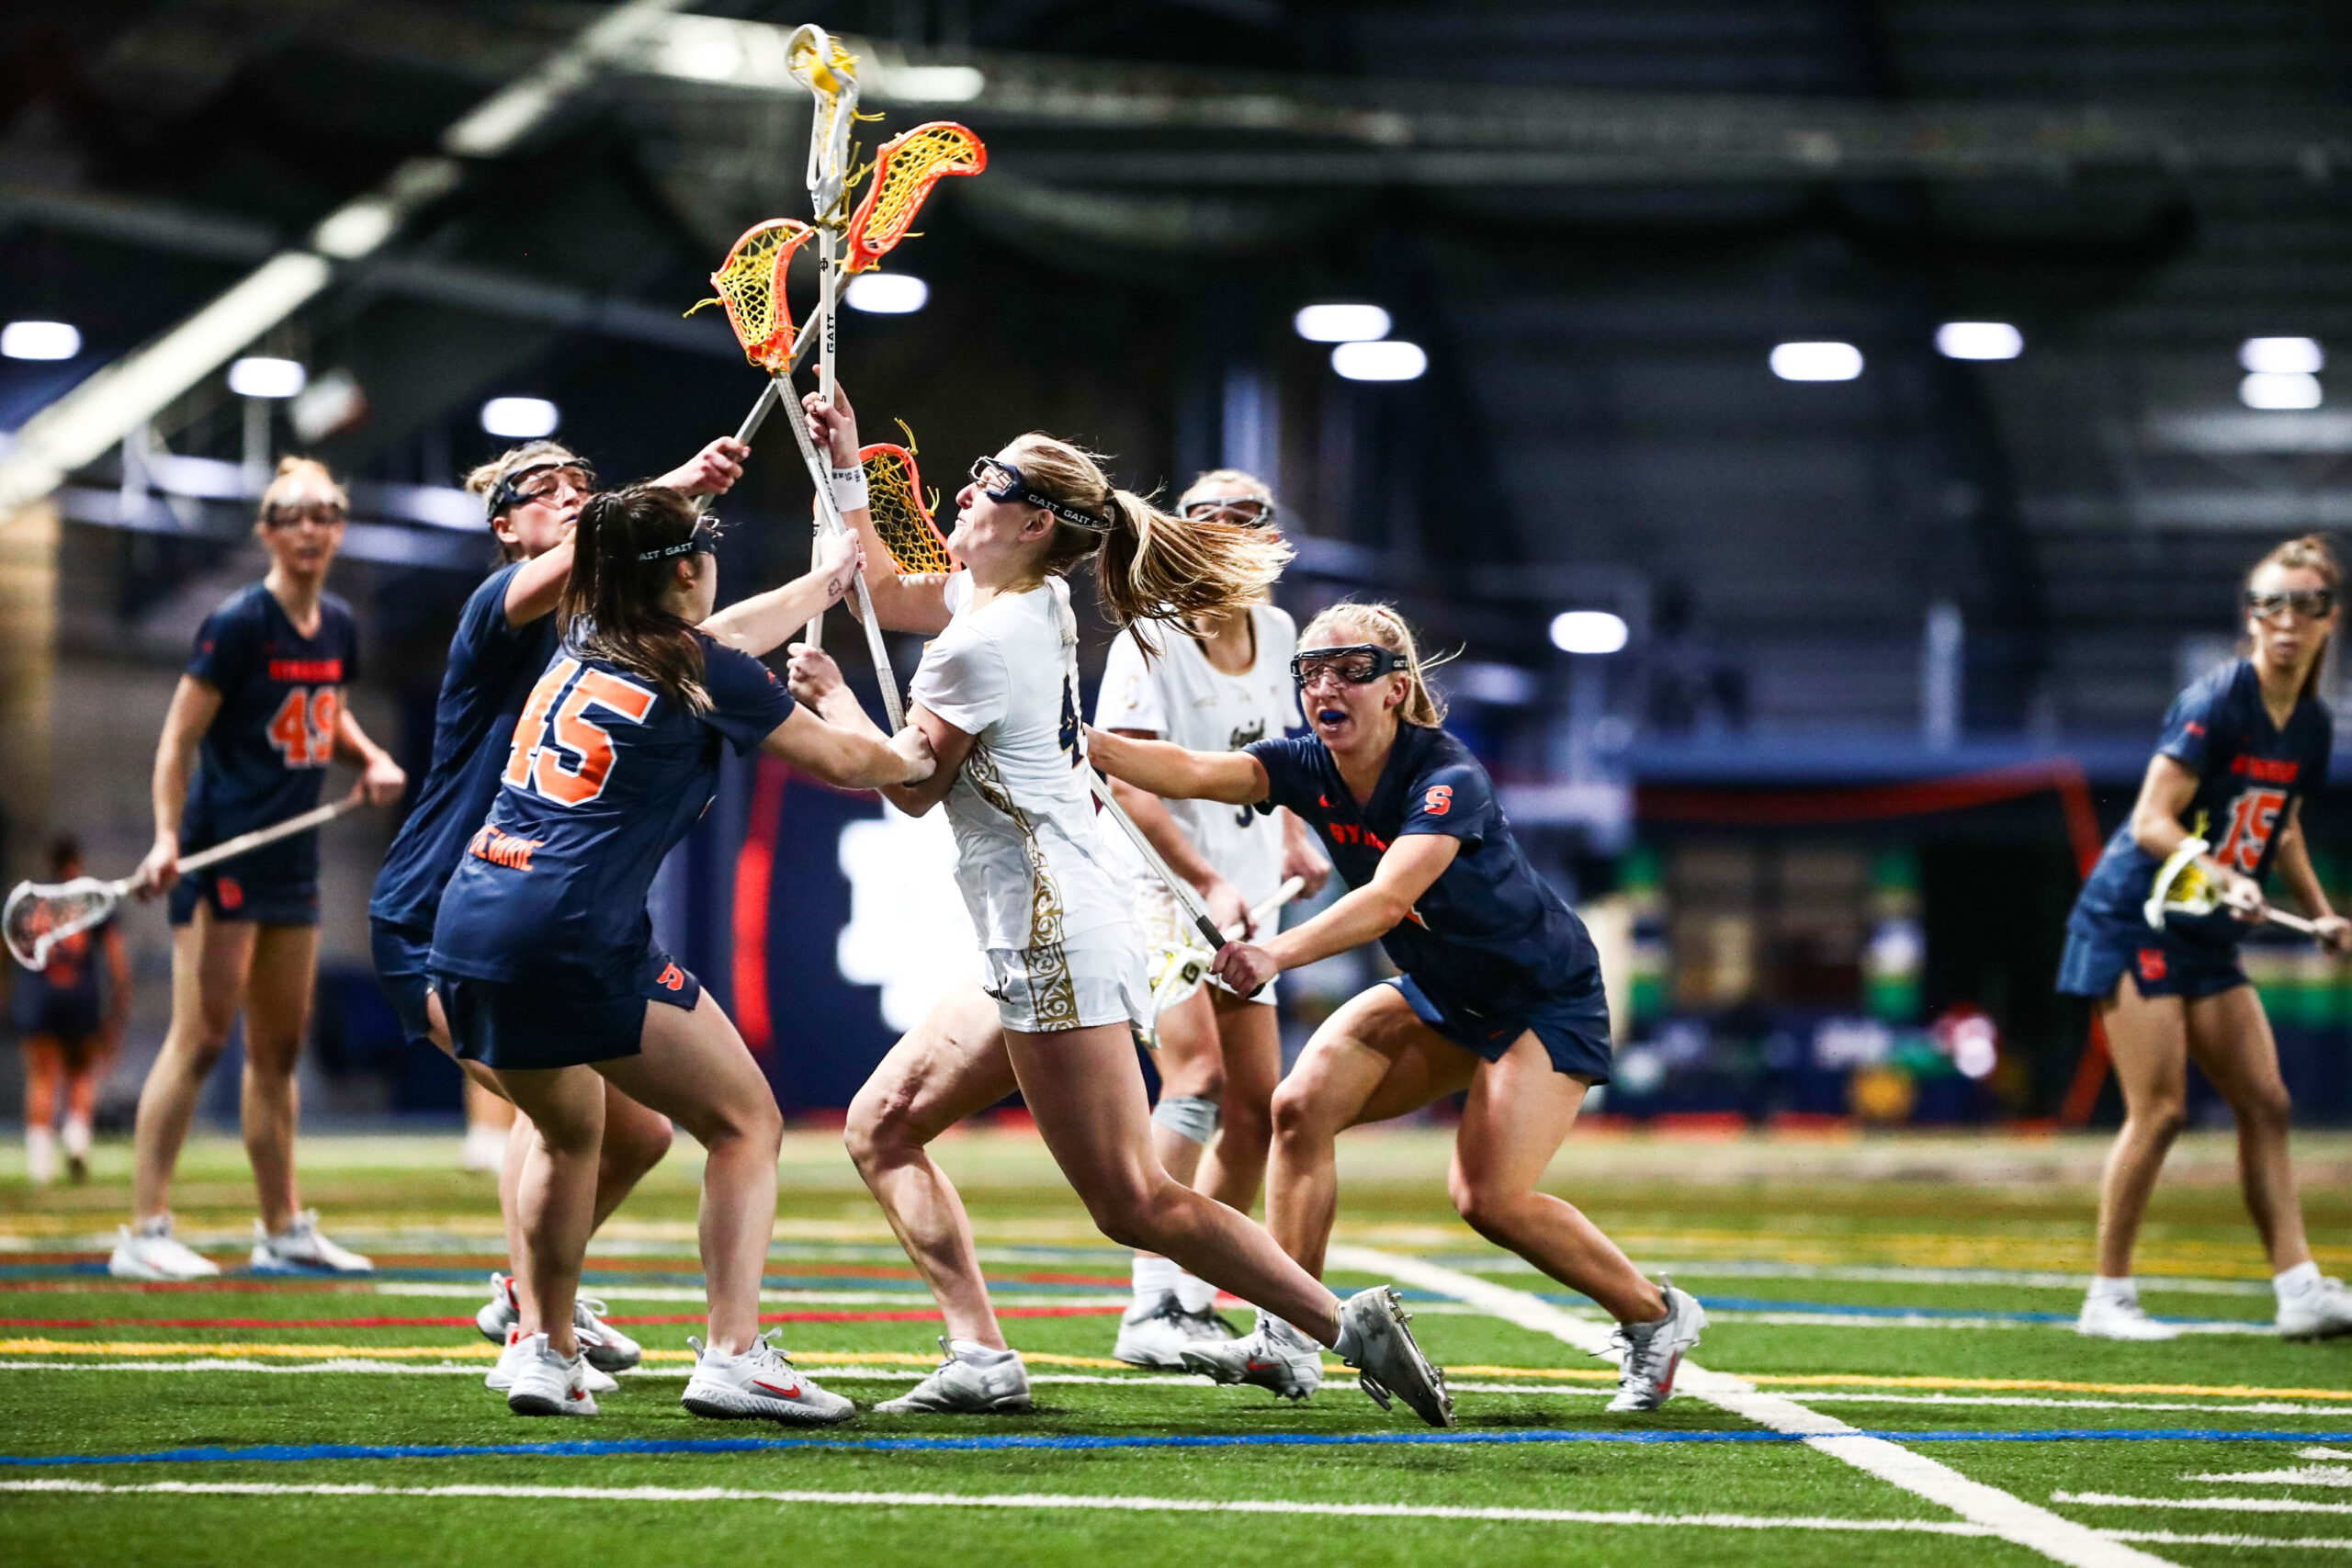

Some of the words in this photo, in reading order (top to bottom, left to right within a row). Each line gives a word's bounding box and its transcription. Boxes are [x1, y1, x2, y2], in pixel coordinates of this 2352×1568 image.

[827, 314, 835, 354] GAIT
[1028, 494, 1059, 512] GAIT
[1064, 510, 1091, 525] GAIT
[639, 550, 661, 560] AIT
[664, 542, 693, 556] GAIT
[266, 685, 336, 769] 49
[501, 657, 658, 807] 45
[1058, 671, 1086, 770] 4
[1424, 785, 1453, 816] S
[2214, 786, 2288, 874] 15
